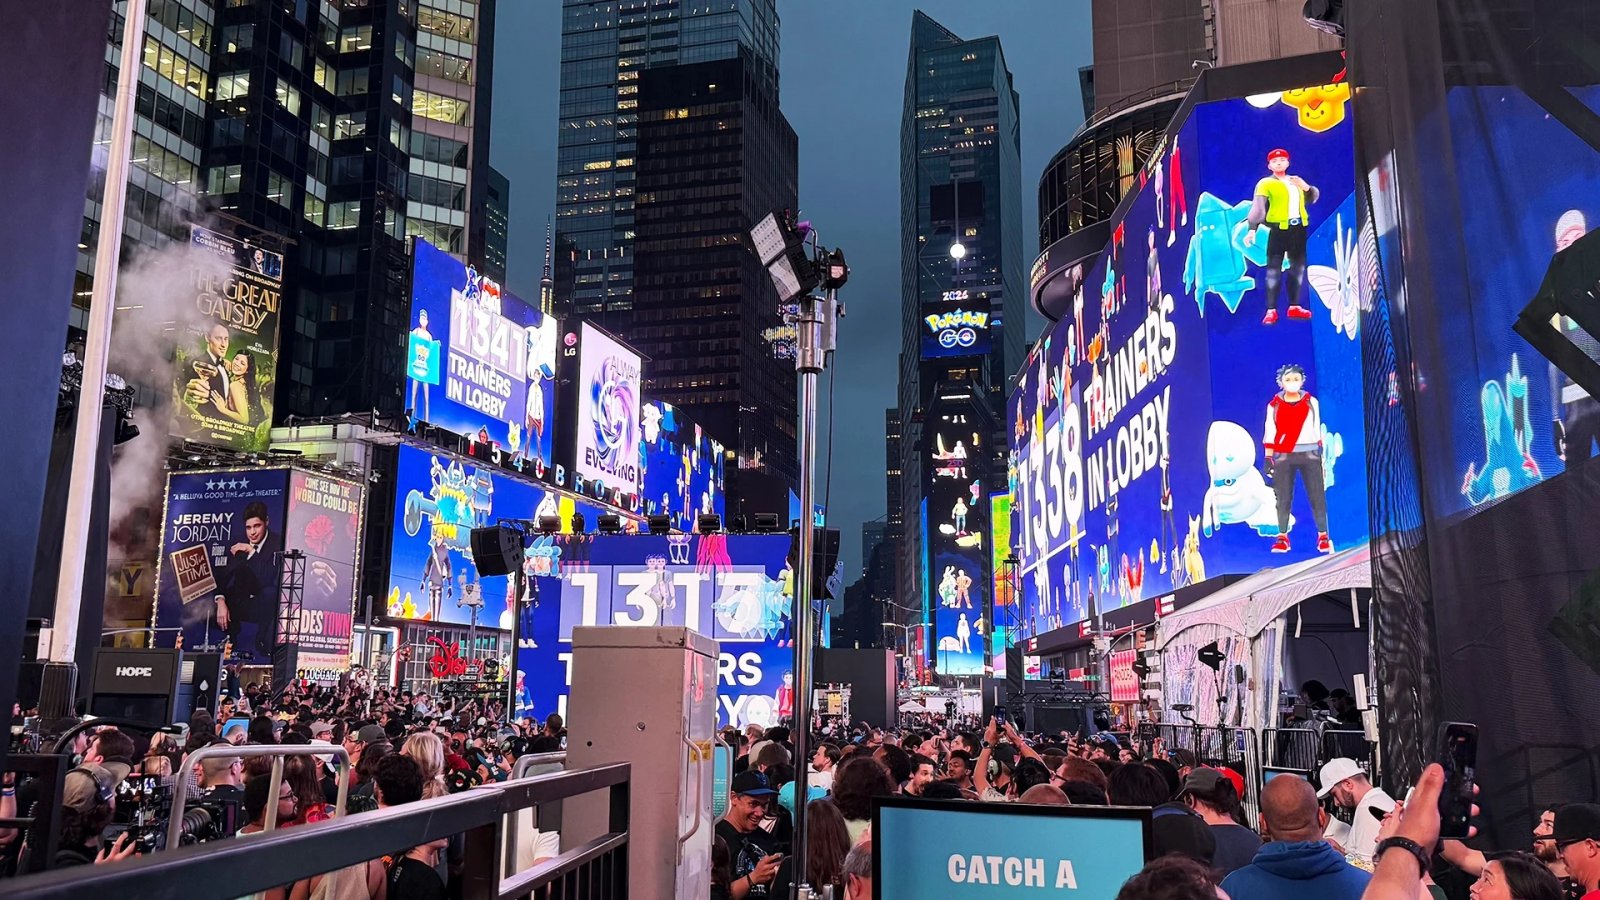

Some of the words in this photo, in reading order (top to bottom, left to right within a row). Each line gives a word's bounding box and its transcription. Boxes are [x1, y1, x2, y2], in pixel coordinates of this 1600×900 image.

[195, 236, 219, 249] CORBIN
[219, 245, 236, 255] BLEU
[254, 275, 282, 290] BROADWAY
[222, 278, 281, 313] GREAT
[942, 289, 969, 301] 2026
[196, 292, 269, 330] GATSBY
[454, 297, 525, 376] 1341
[938, 327, 977, 348] GO
[564, 347, 577, 357] LG
[449, 353, 512, 399] TRAINERS
[447, 376, 463, 402] IN
[465, 384, 507, 419] LOBBY
[1019, 401, 1084, 562] 1338
[1083, 293, 1177, 441] TRAINERS
[1087, 445, 1105, 512] IN
[1106, 384, 1171, 497] LOBBY
[180, 493, 203, 501] HELLUVA
[204, 491, 225, 499] GOOD
[304, 477, 319, 491] COME
[320, 480, 329, 493] SEE
[329, 482, 340, 496] HOW
[340, 485, 351, 498] THE
[294, 486, 322, 506] WORLD
[322, 494, 347, 513] COULD
[173, 512, 235, 525] JEREMY
[171, 524, 232, 544] JORDAN
[179, 553, 199, 571] JUST
[185, 562, 210, 583] TIME
[116, 666, 153, 677] HOPE
[304, 669, 341, 681] LUGGAGE
[947, 853, 1045, 888] CATCH
[1055, 859, 1078, 889] A
